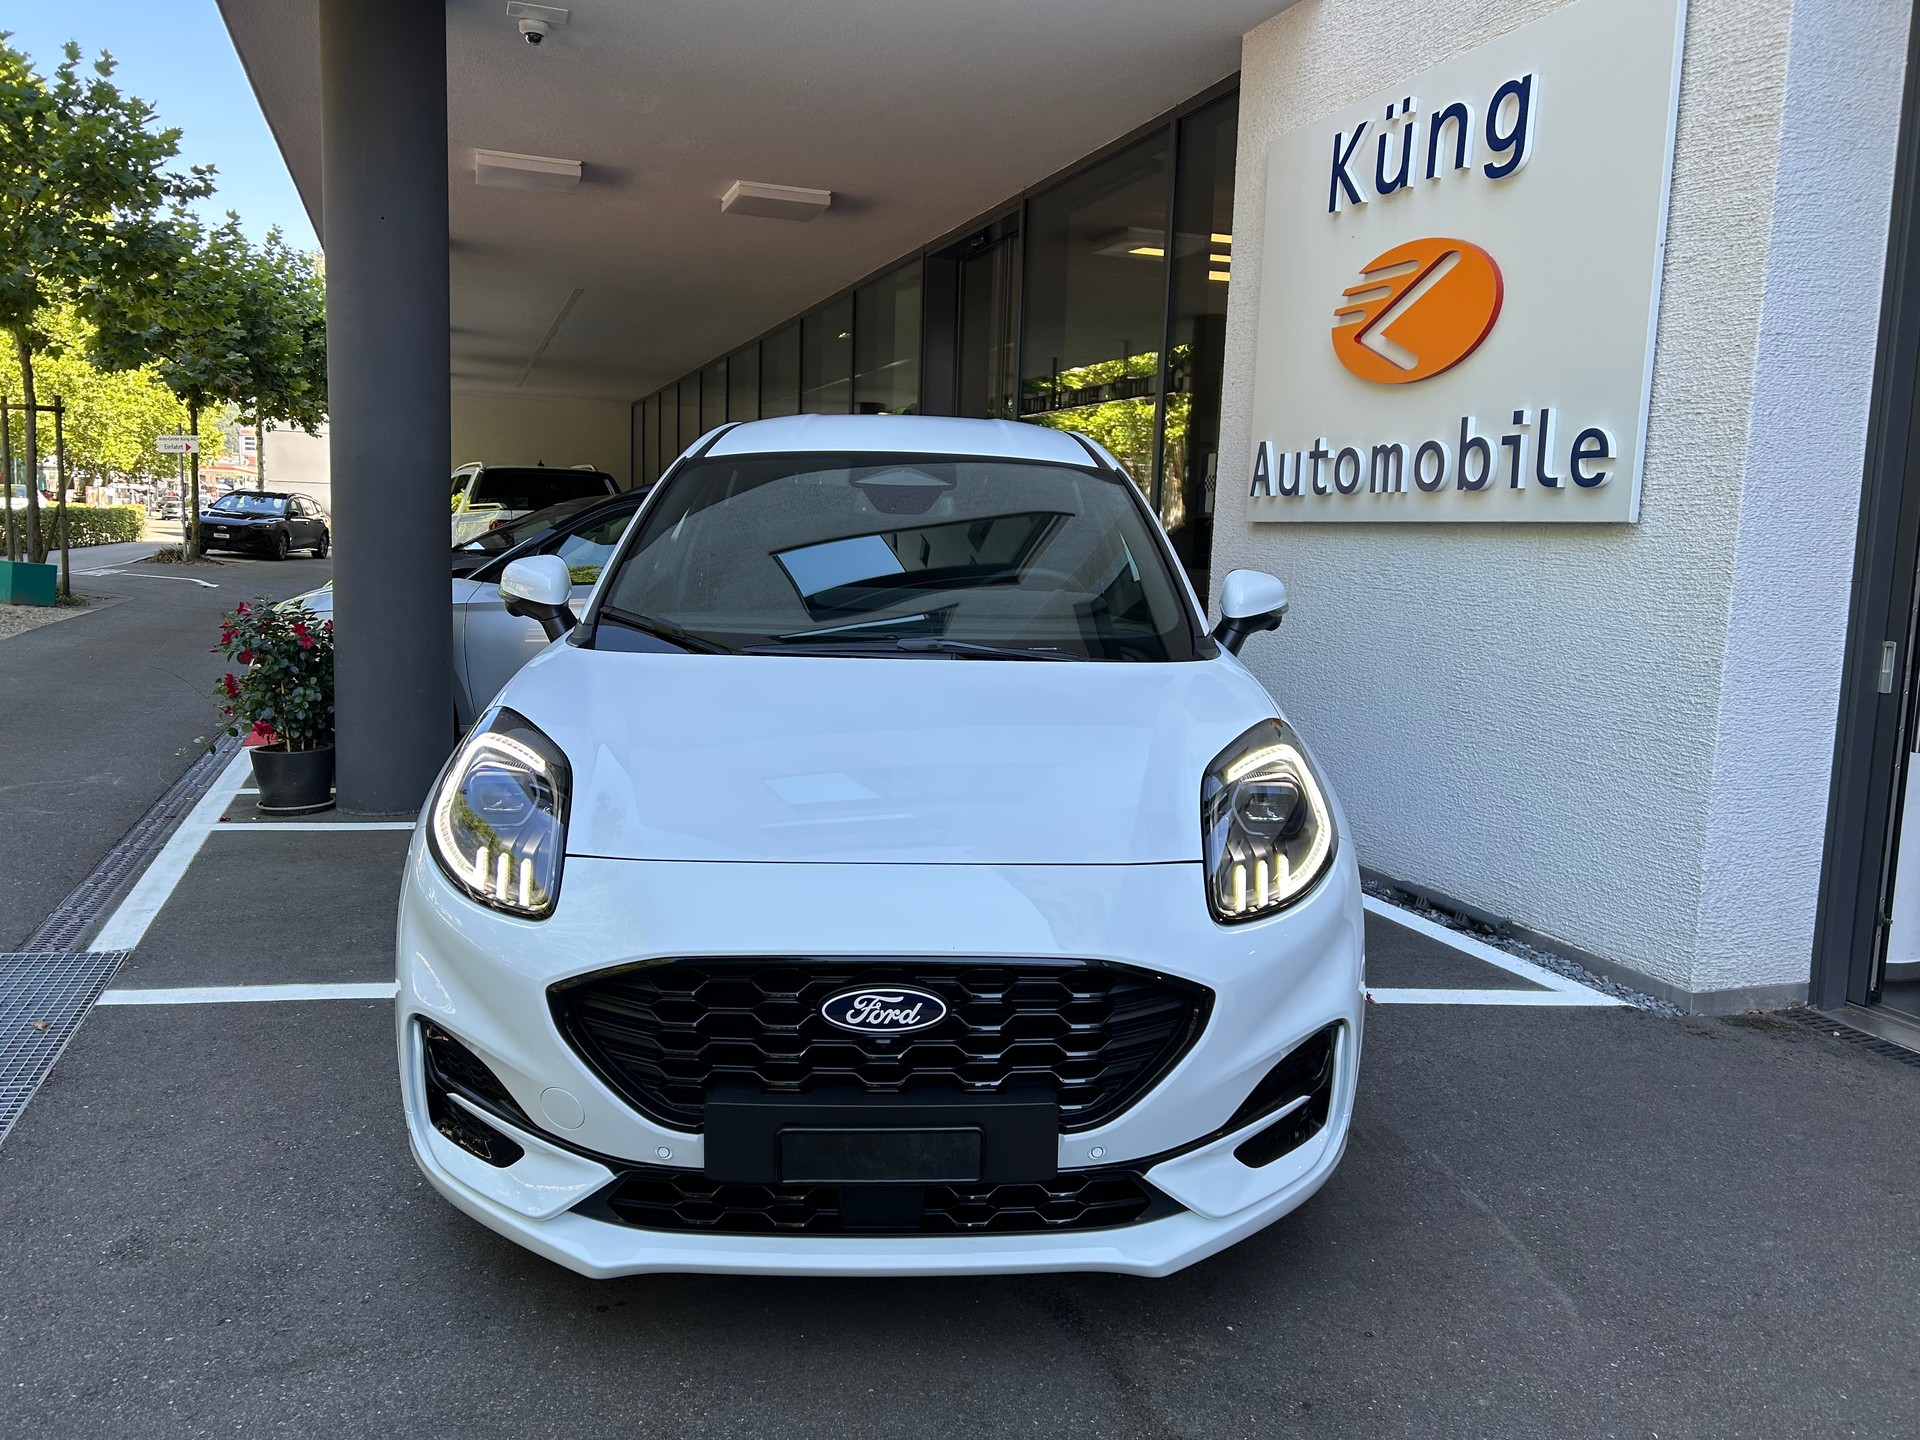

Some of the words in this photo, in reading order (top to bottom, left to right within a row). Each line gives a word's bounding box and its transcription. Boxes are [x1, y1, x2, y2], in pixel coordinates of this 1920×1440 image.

[1328, 73, 1538, 213] Küng
[1250, 408, 1616, 497] Automobile
[845, 994, 923, 1025] Ford
